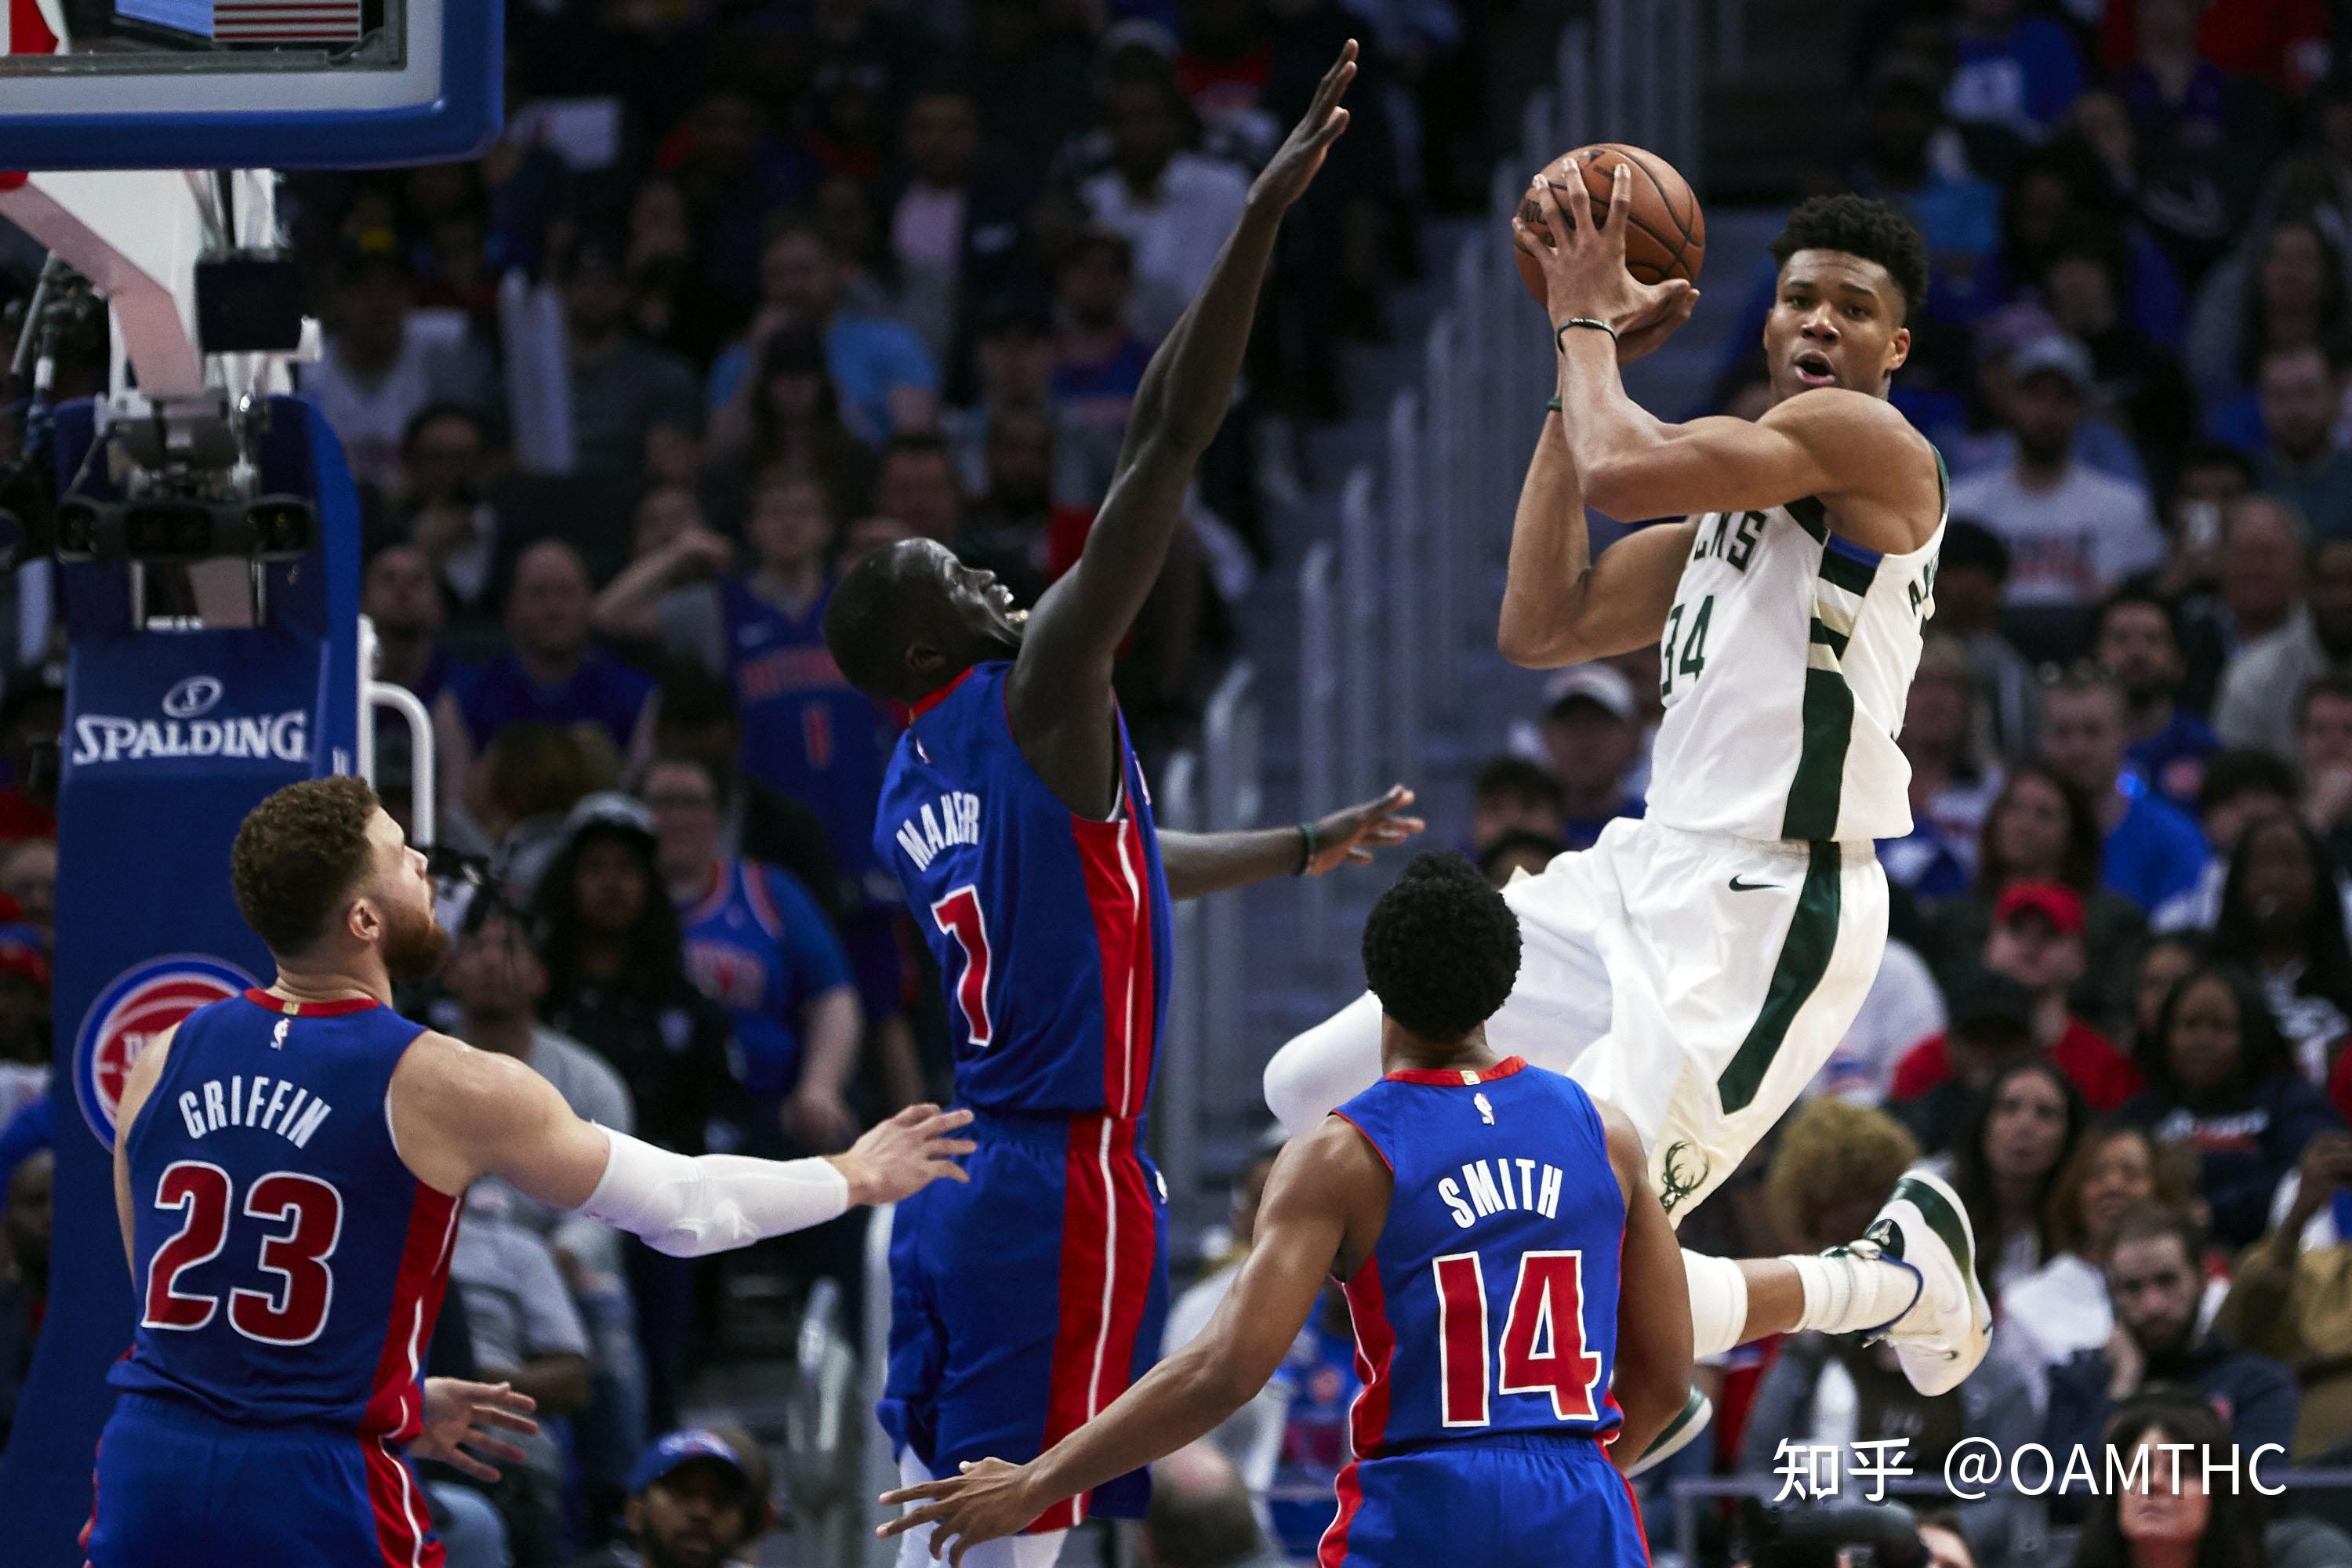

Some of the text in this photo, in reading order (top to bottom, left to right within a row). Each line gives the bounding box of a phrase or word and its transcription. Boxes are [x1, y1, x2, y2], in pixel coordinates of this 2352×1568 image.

[1661, 595, 1714, 696] 34
[72, 710, 307, 766] SPALDING
[931, 884, 991, 1047] 7
[179, 1075, 332, 1149] GRIFFIN
[1438, 1158, 1563, 1229] SMITH
[141, 1160, 343, 1347] 23
[1432, 1250, 1602, 1428] 14
